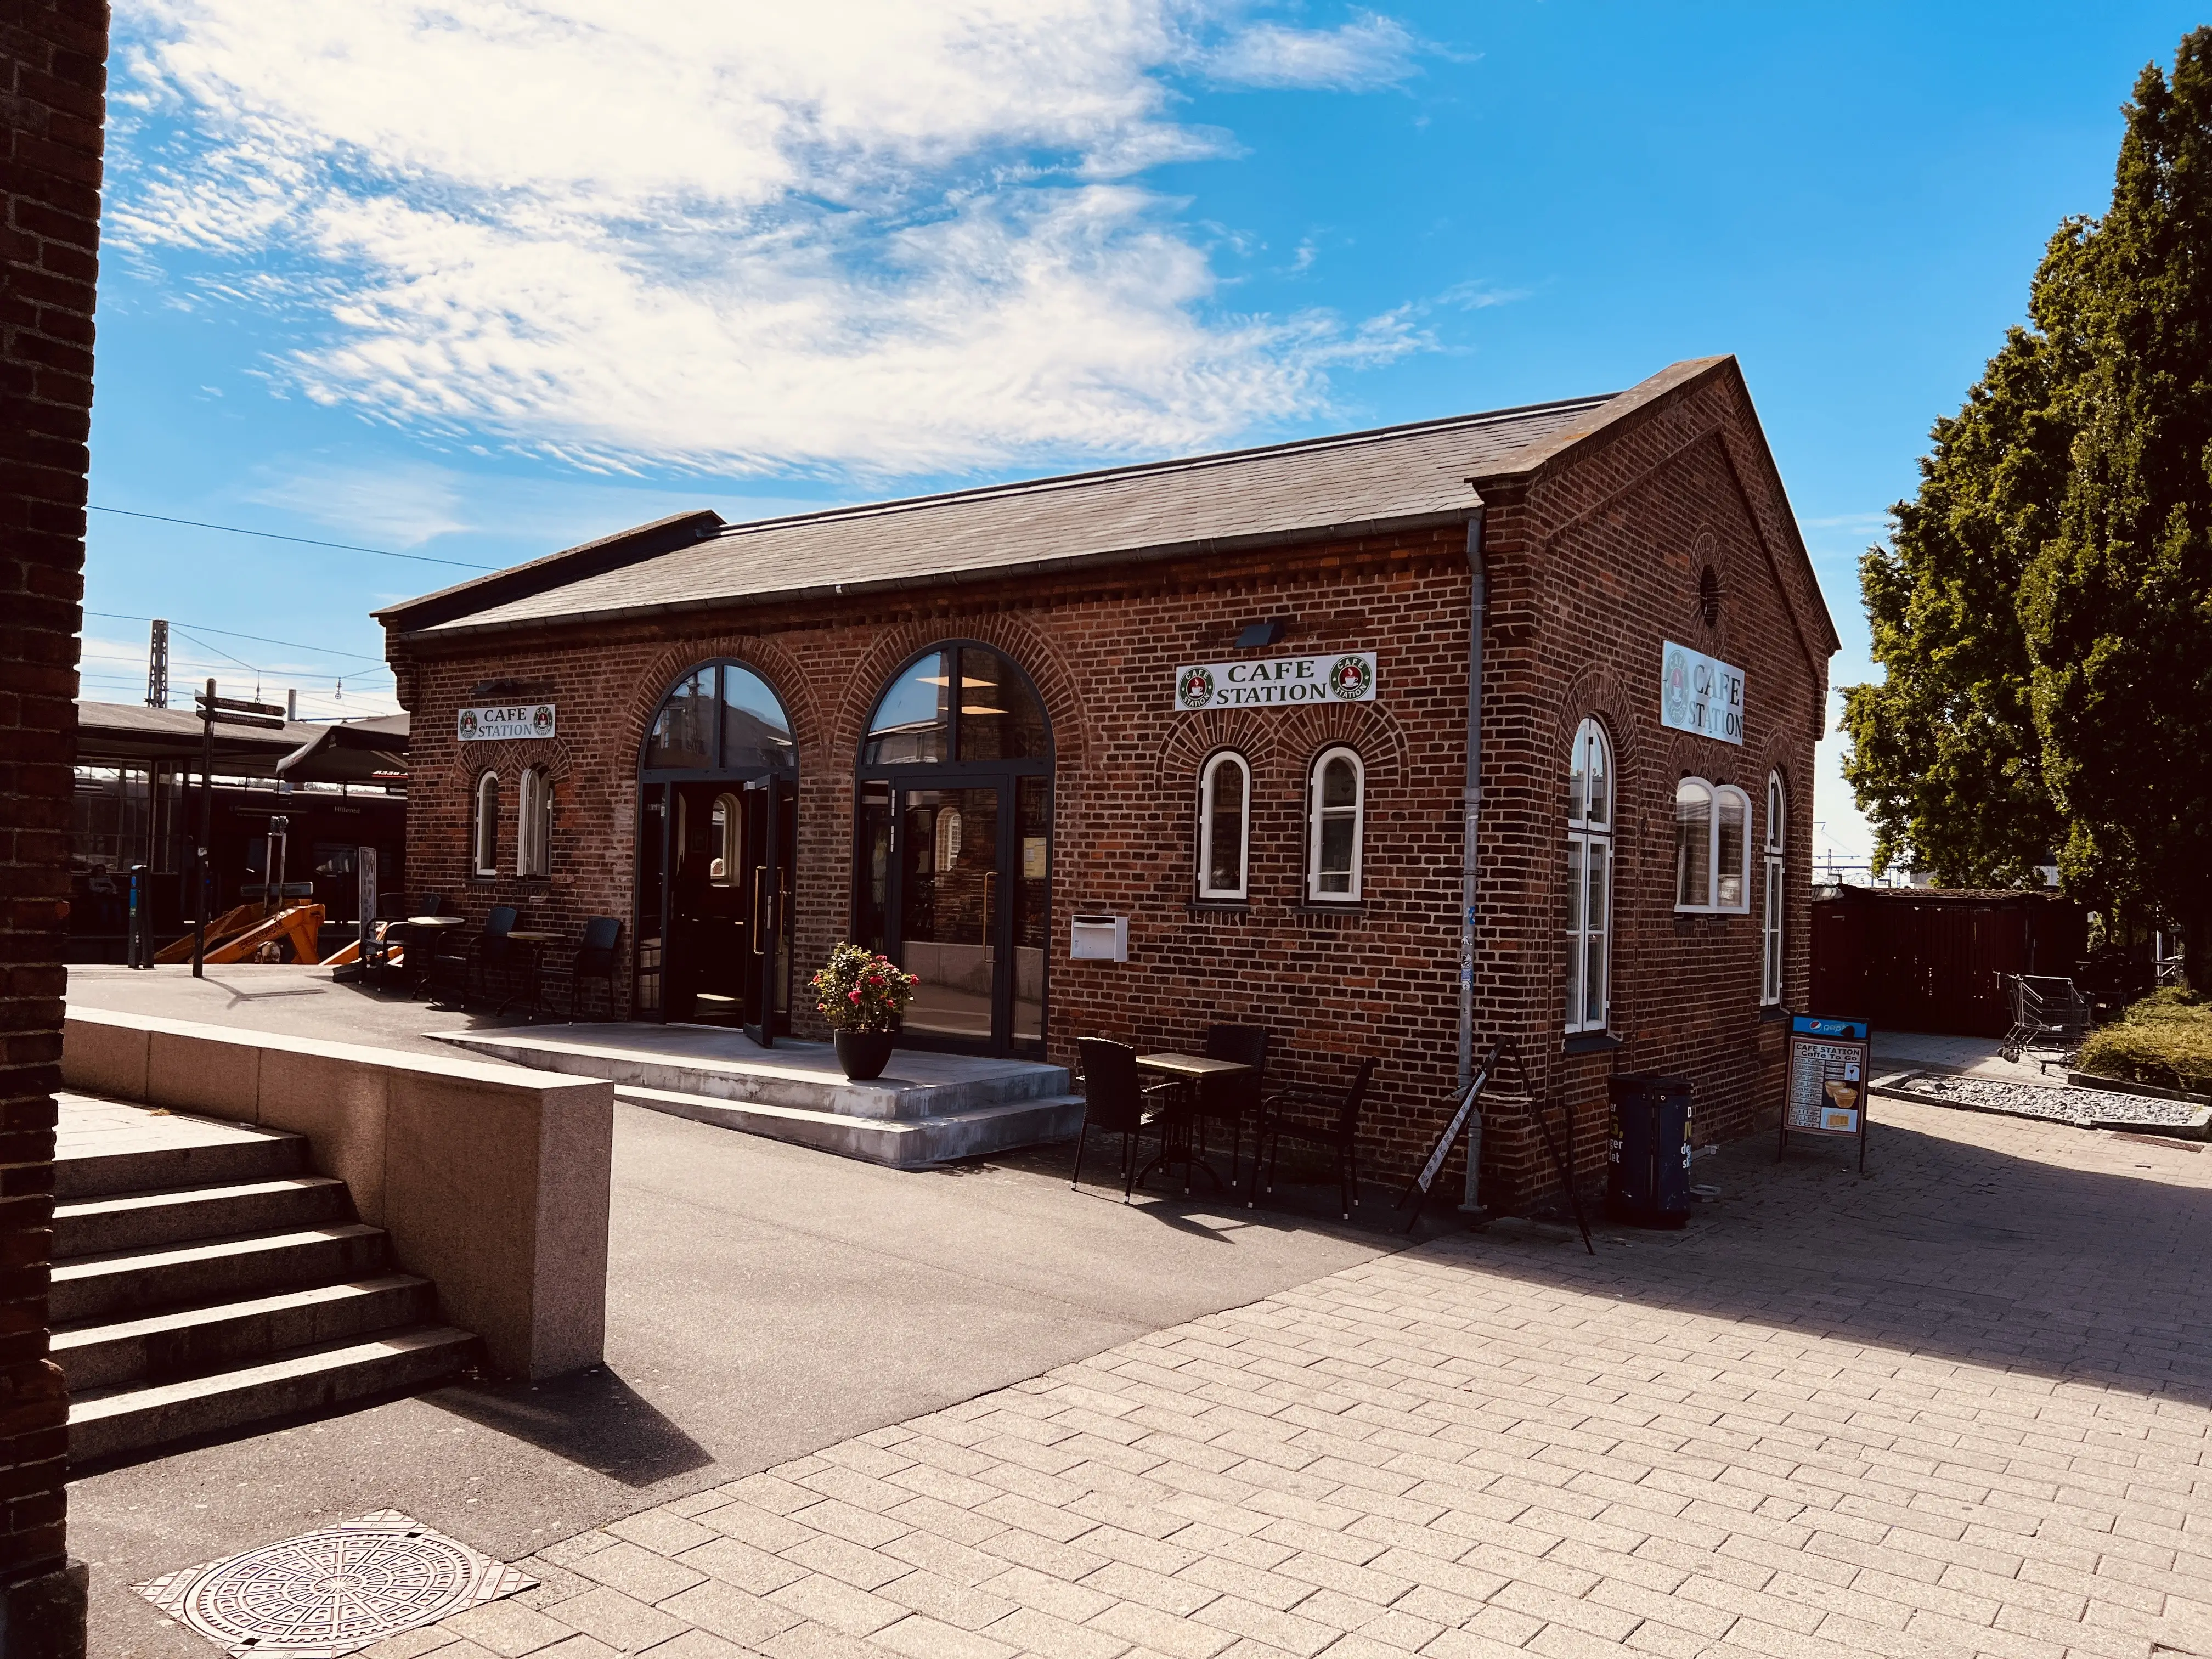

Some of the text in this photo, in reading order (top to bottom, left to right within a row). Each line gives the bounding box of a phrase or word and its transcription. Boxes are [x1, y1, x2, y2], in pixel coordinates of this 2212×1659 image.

[1228, 660, 1314, 683] CAFE
[1337, 658, 1365, 670] CAFE
[1184, 669, 1209, 681] CAFE
[1334, 683, 1367, 699] STATION
[1693, 664, 1740, 707] CAFE
[1182, 693, 1210, 708] STATION
[1216, 683, 1328, 705] STATION
[484, 708, 527, 723] CAFE
[1688, 701, 1743, 738] STATION
[478, 724, 533, 737] STATION
[1823, 1024, 1848, 1032] peps
[1796, 1043, 1860, 1056] CAFE STATION
[1801, 1051, 1826, 1059] Coffe
